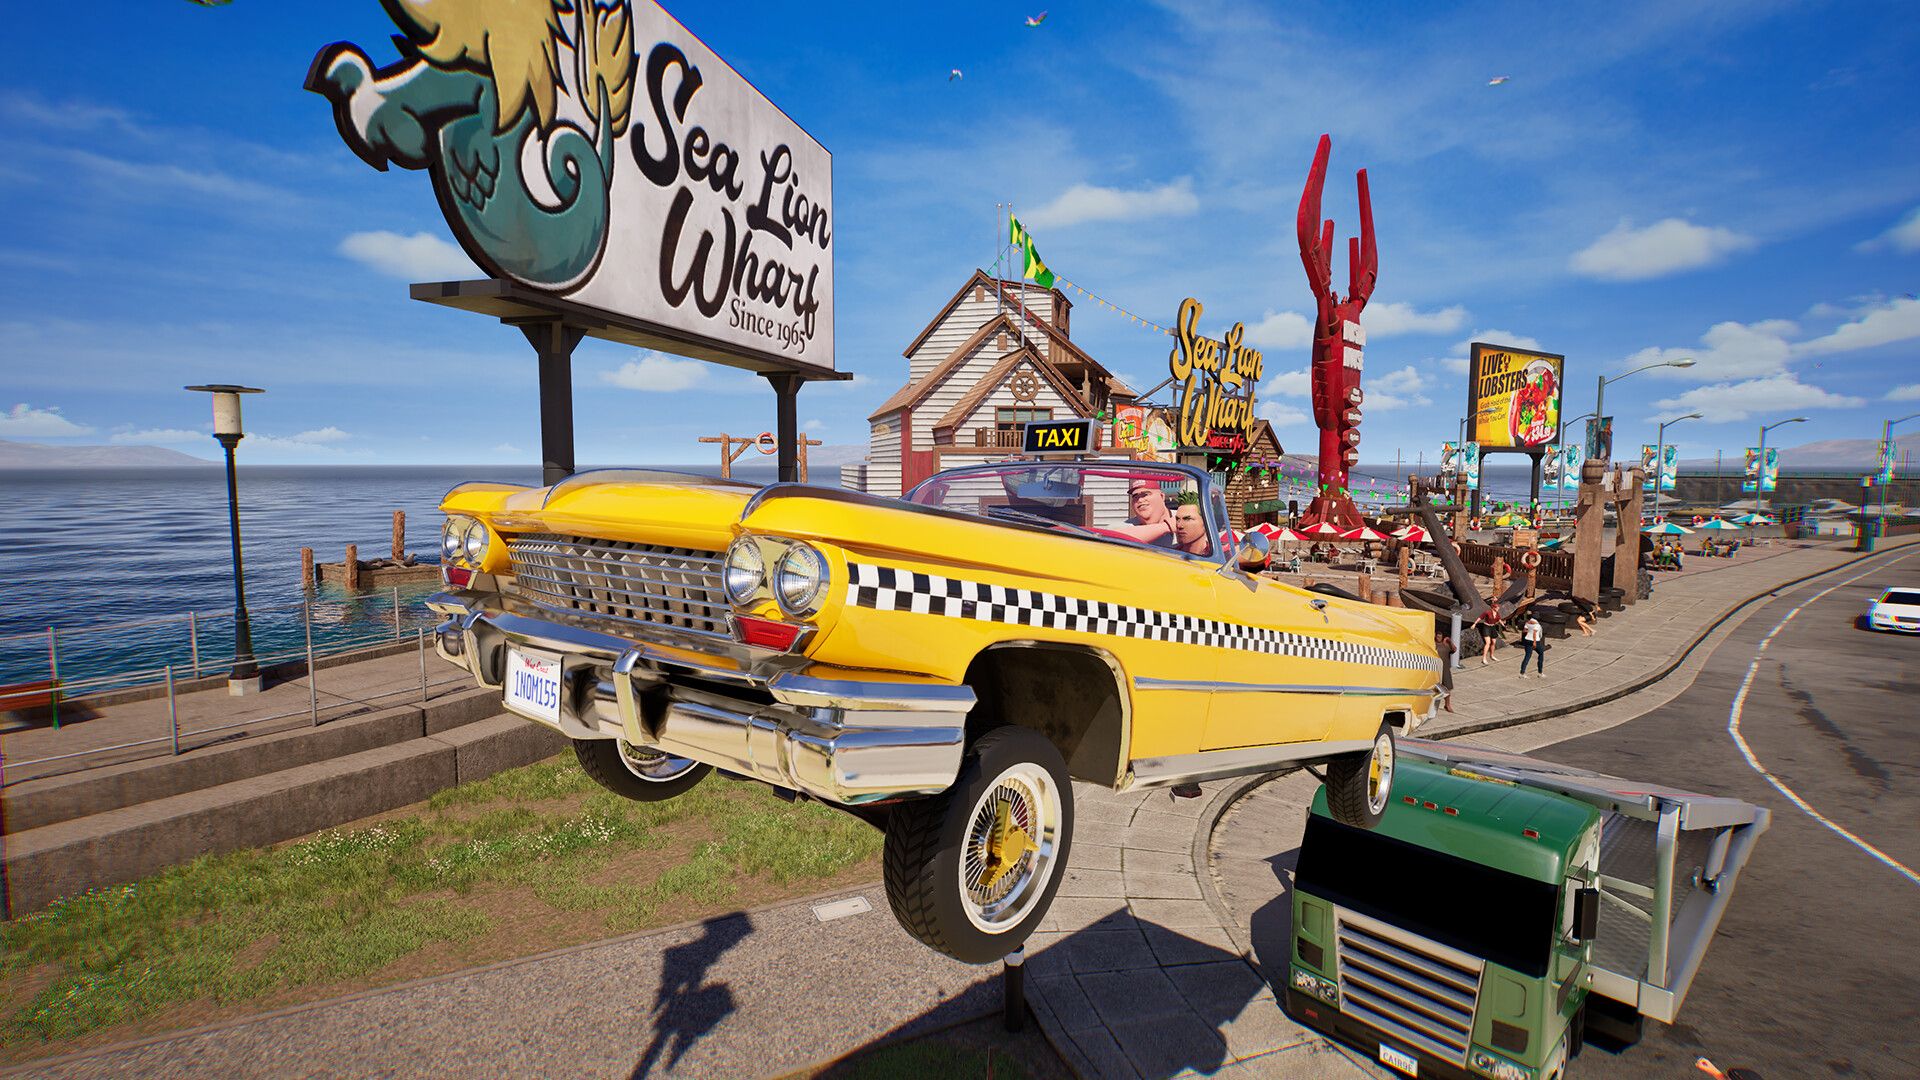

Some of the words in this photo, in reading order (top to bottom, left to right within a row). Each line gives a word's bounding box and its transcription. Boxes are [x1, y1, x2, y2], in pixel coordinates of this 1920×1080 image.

[631, 42, 744, 202] Sea
[746, 144, 831, 250] Lion
[659, 186, 820, 341] Wharf
[729, 298, 774, 335] Since
[777, 321, 807, 355] 1965
[1169, 297, 1219, 381] Sea
[1219, 321, 1264, 388] Lion
[1479, 369, 1528, 399] LOBSTERS
[1482, 353, 1504, 376] LIVE
[1035, 428, 1080, 447] TAXI
[1181, 374, 1256, 447] Wharf
[515, 671, 557, 708] 1NOM155
